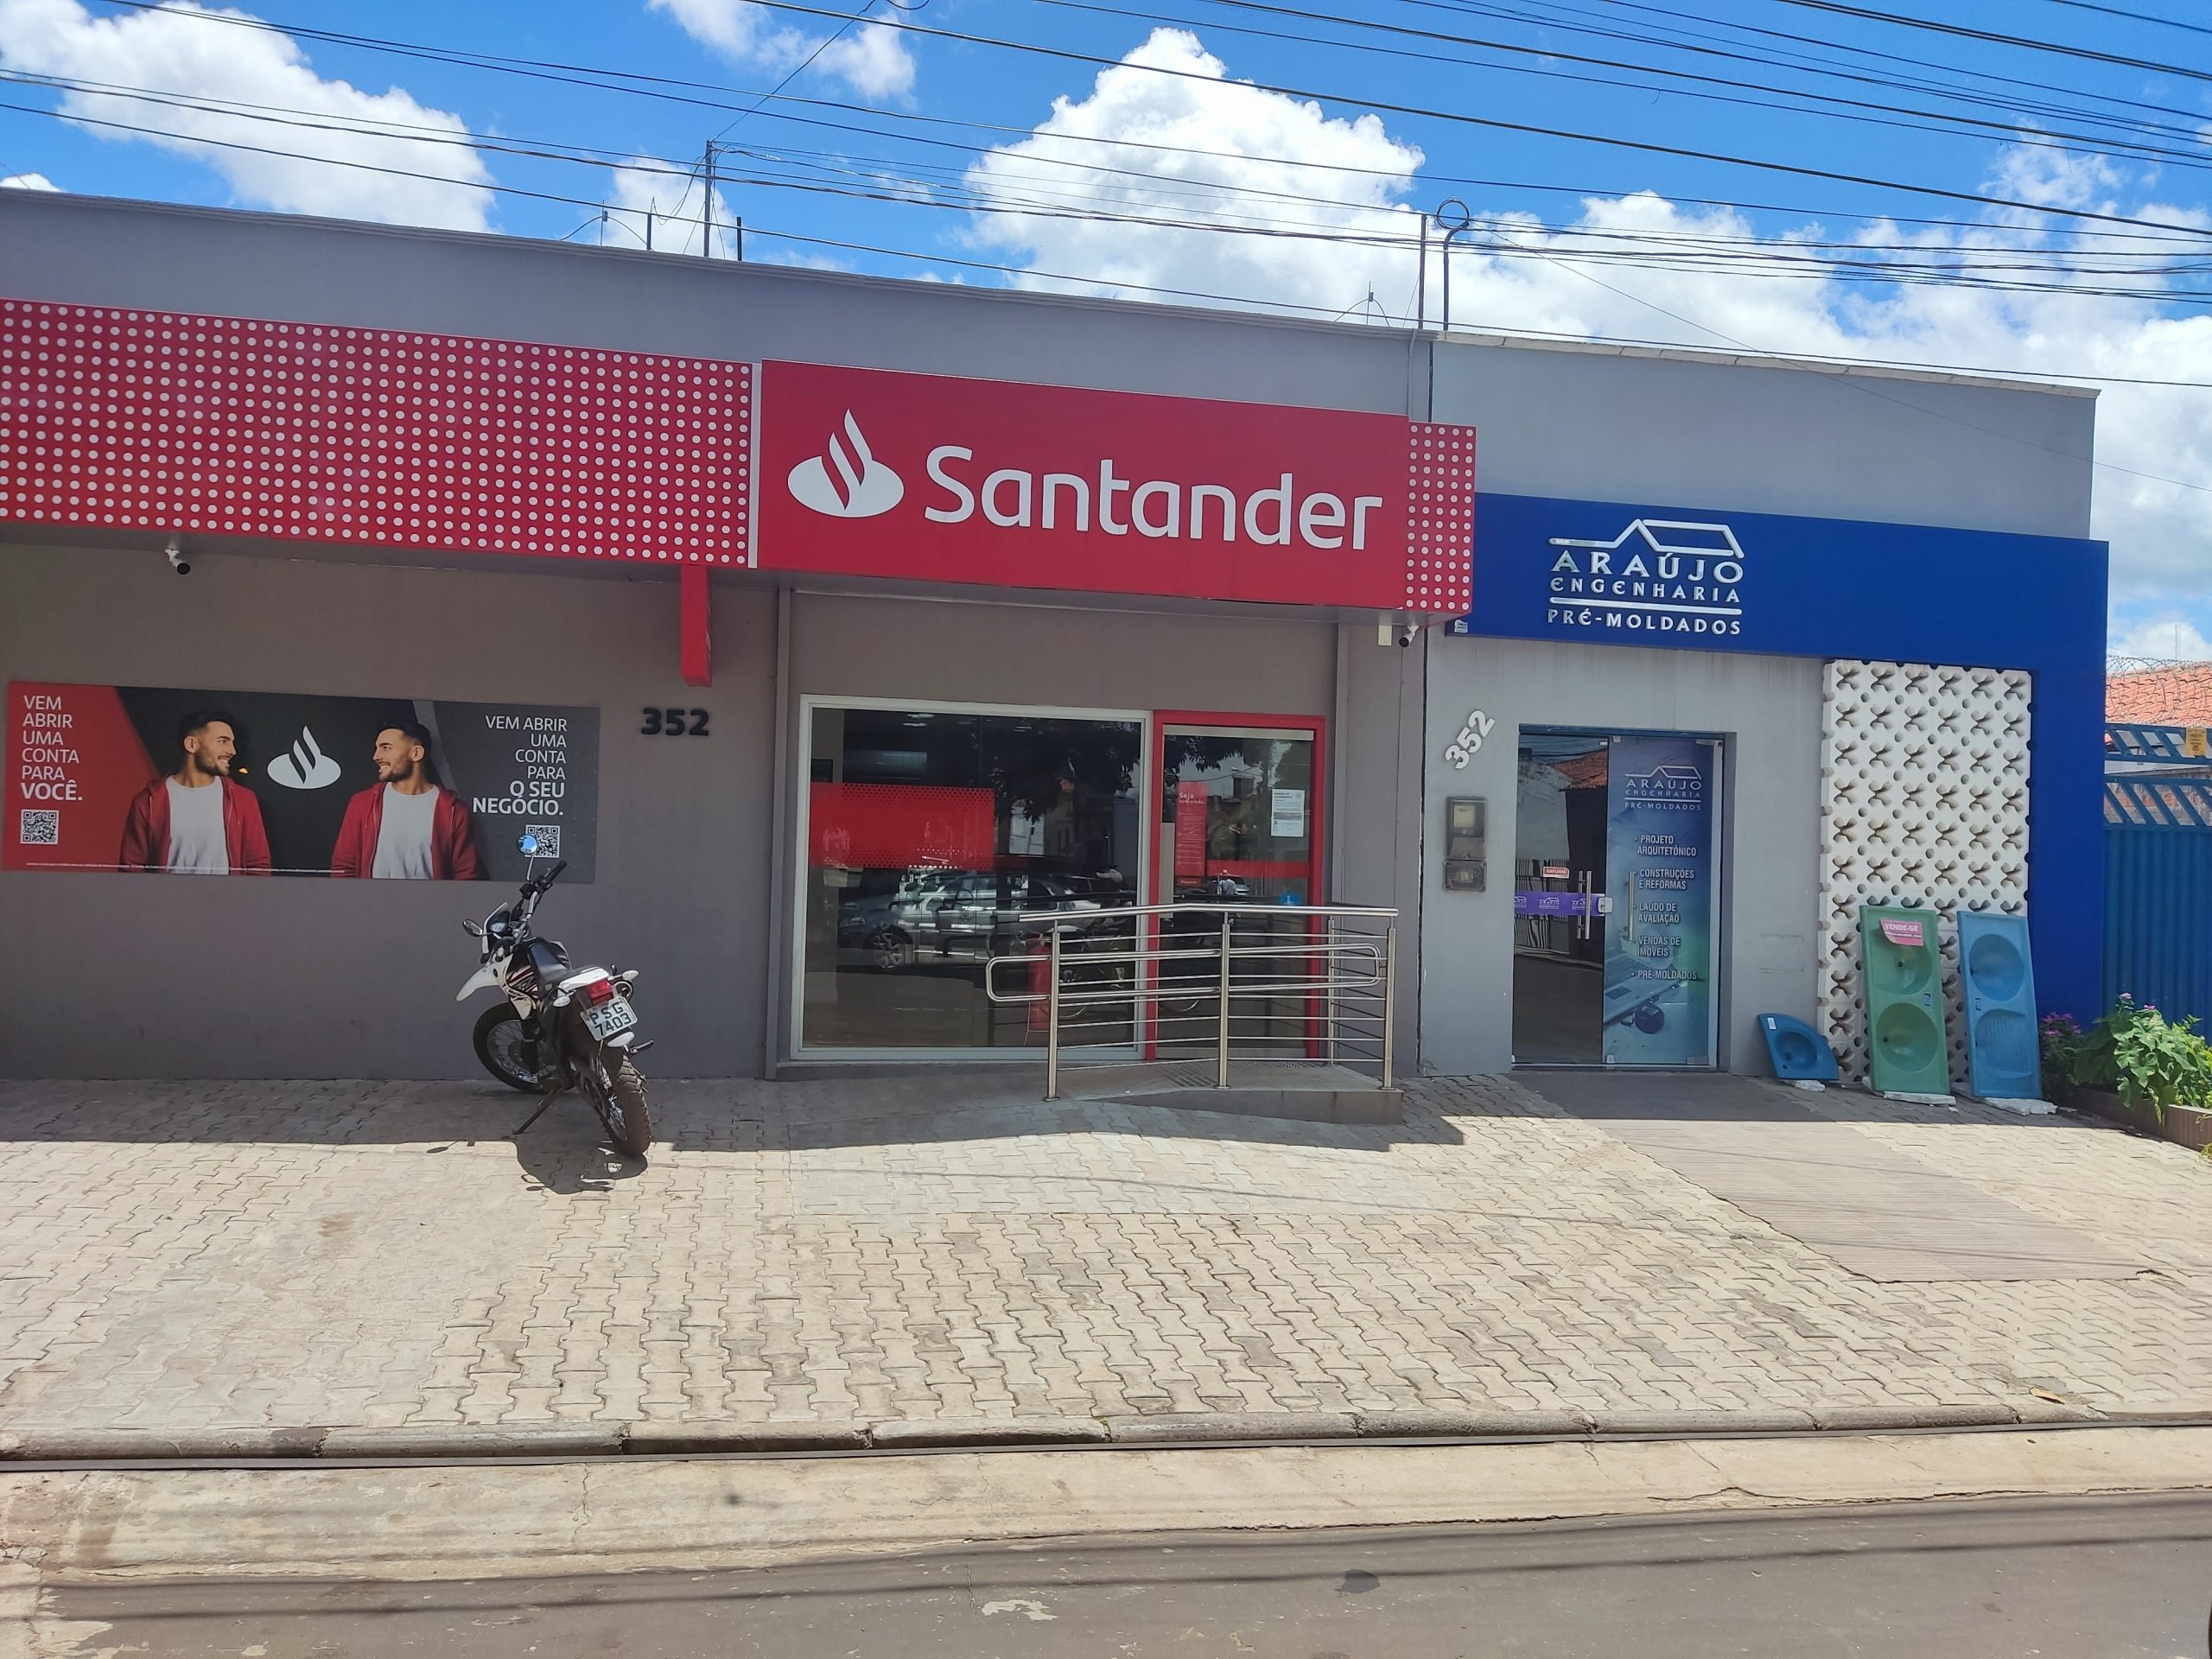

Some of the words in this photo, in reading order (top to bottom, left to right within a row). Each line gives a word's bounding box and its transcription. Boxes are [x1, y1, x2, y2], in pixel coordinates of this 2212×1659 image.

[924, 445, 1383, 550] Santander
[1550, 549, 1744, 583] ARAÚJO
[1550, 577, 1740, 603] ENGENHARIA
[1547, 607, 1742, 635] PRÉ-MOLDADOS
[23, 695, 62, 711] VEM
[22, 712, 73, 728] ABRIR
[486, 715, 519, 730] VEM
[523, 717, 568, 732] ABRIR
[641, 708, 709, 736] 352
[22, 729, 64, 746] UMA
[531, 734, 567, 748] UMA
[1445, 710, 1495, 769] 352
[22, 747, 79, 764] CONTA
[515, 748, 567, 764] CONTA
[22, 766, 65, 781] PARA
[527, 766, 566, 780] PARA
[21, 779, 83, 801] VOCÊ.
[510, 780, 524, 797] O
[529, 781, 565, 798] SEU
[1626, 778, 1701, 791] ARAÚJO
[1625, 789, 1700, 798] ENGENHARIA
[473, 794, 564, 816] NEGÓCIO.
[1640, 835, 1674, 844] PROJETO
[1637, 844, 1697, 856] ARQUITETÔNICO
[1639, 880, 1643, 889] E
[1645, 880, 1687, 890] REFORMAS
[1639, 902, 1664, 912] LAUDO
[1666, 903, 1677, 912] DE
[1884, 923, 1919, 932] VENDE-SE
[1638, 936, 1669, 946] VENDAS
[1670, 937, 1681, 946] DE
[588, 1002, 624, 1026] PSG
[594, 1012, 632, 1036] 7403
